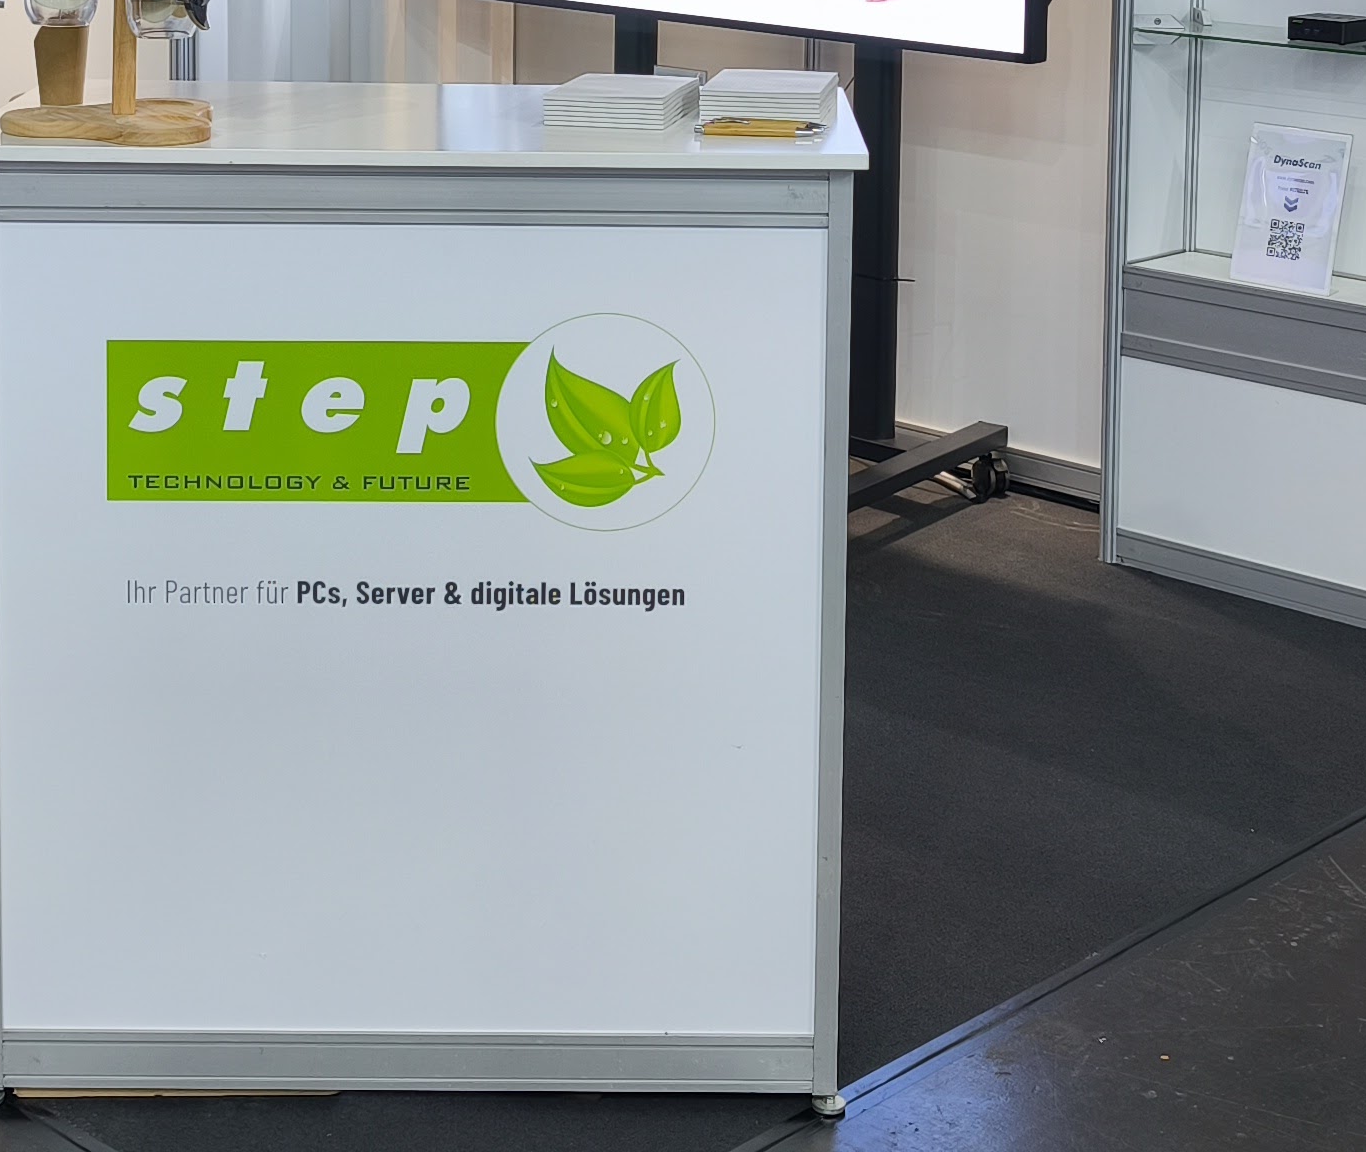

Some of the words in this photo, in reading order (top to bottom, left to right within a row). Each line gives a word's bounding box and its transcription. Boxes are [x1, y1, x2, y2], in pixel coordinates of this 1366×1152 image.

[1274, 154, 1321, 170] DynaScan
[128, 360, 471, 454] step
[127, 474, 321, 491] TECHNOLOGY
[332, 474, 350, 491] &
[362, 474, 471, 491] FUTURE
[126, 580, 156, 605] Ihr
[165, 580, 249, 605] Partner
[256, 580, 289, 605] für
[296, 581, 348, 609] PCs,
[356, 581, 436, 606] Server
[443, 581, 463, 606] &
[471, 581, 562, 612] digitale
[569, 581, 686, 612] Lösungen
